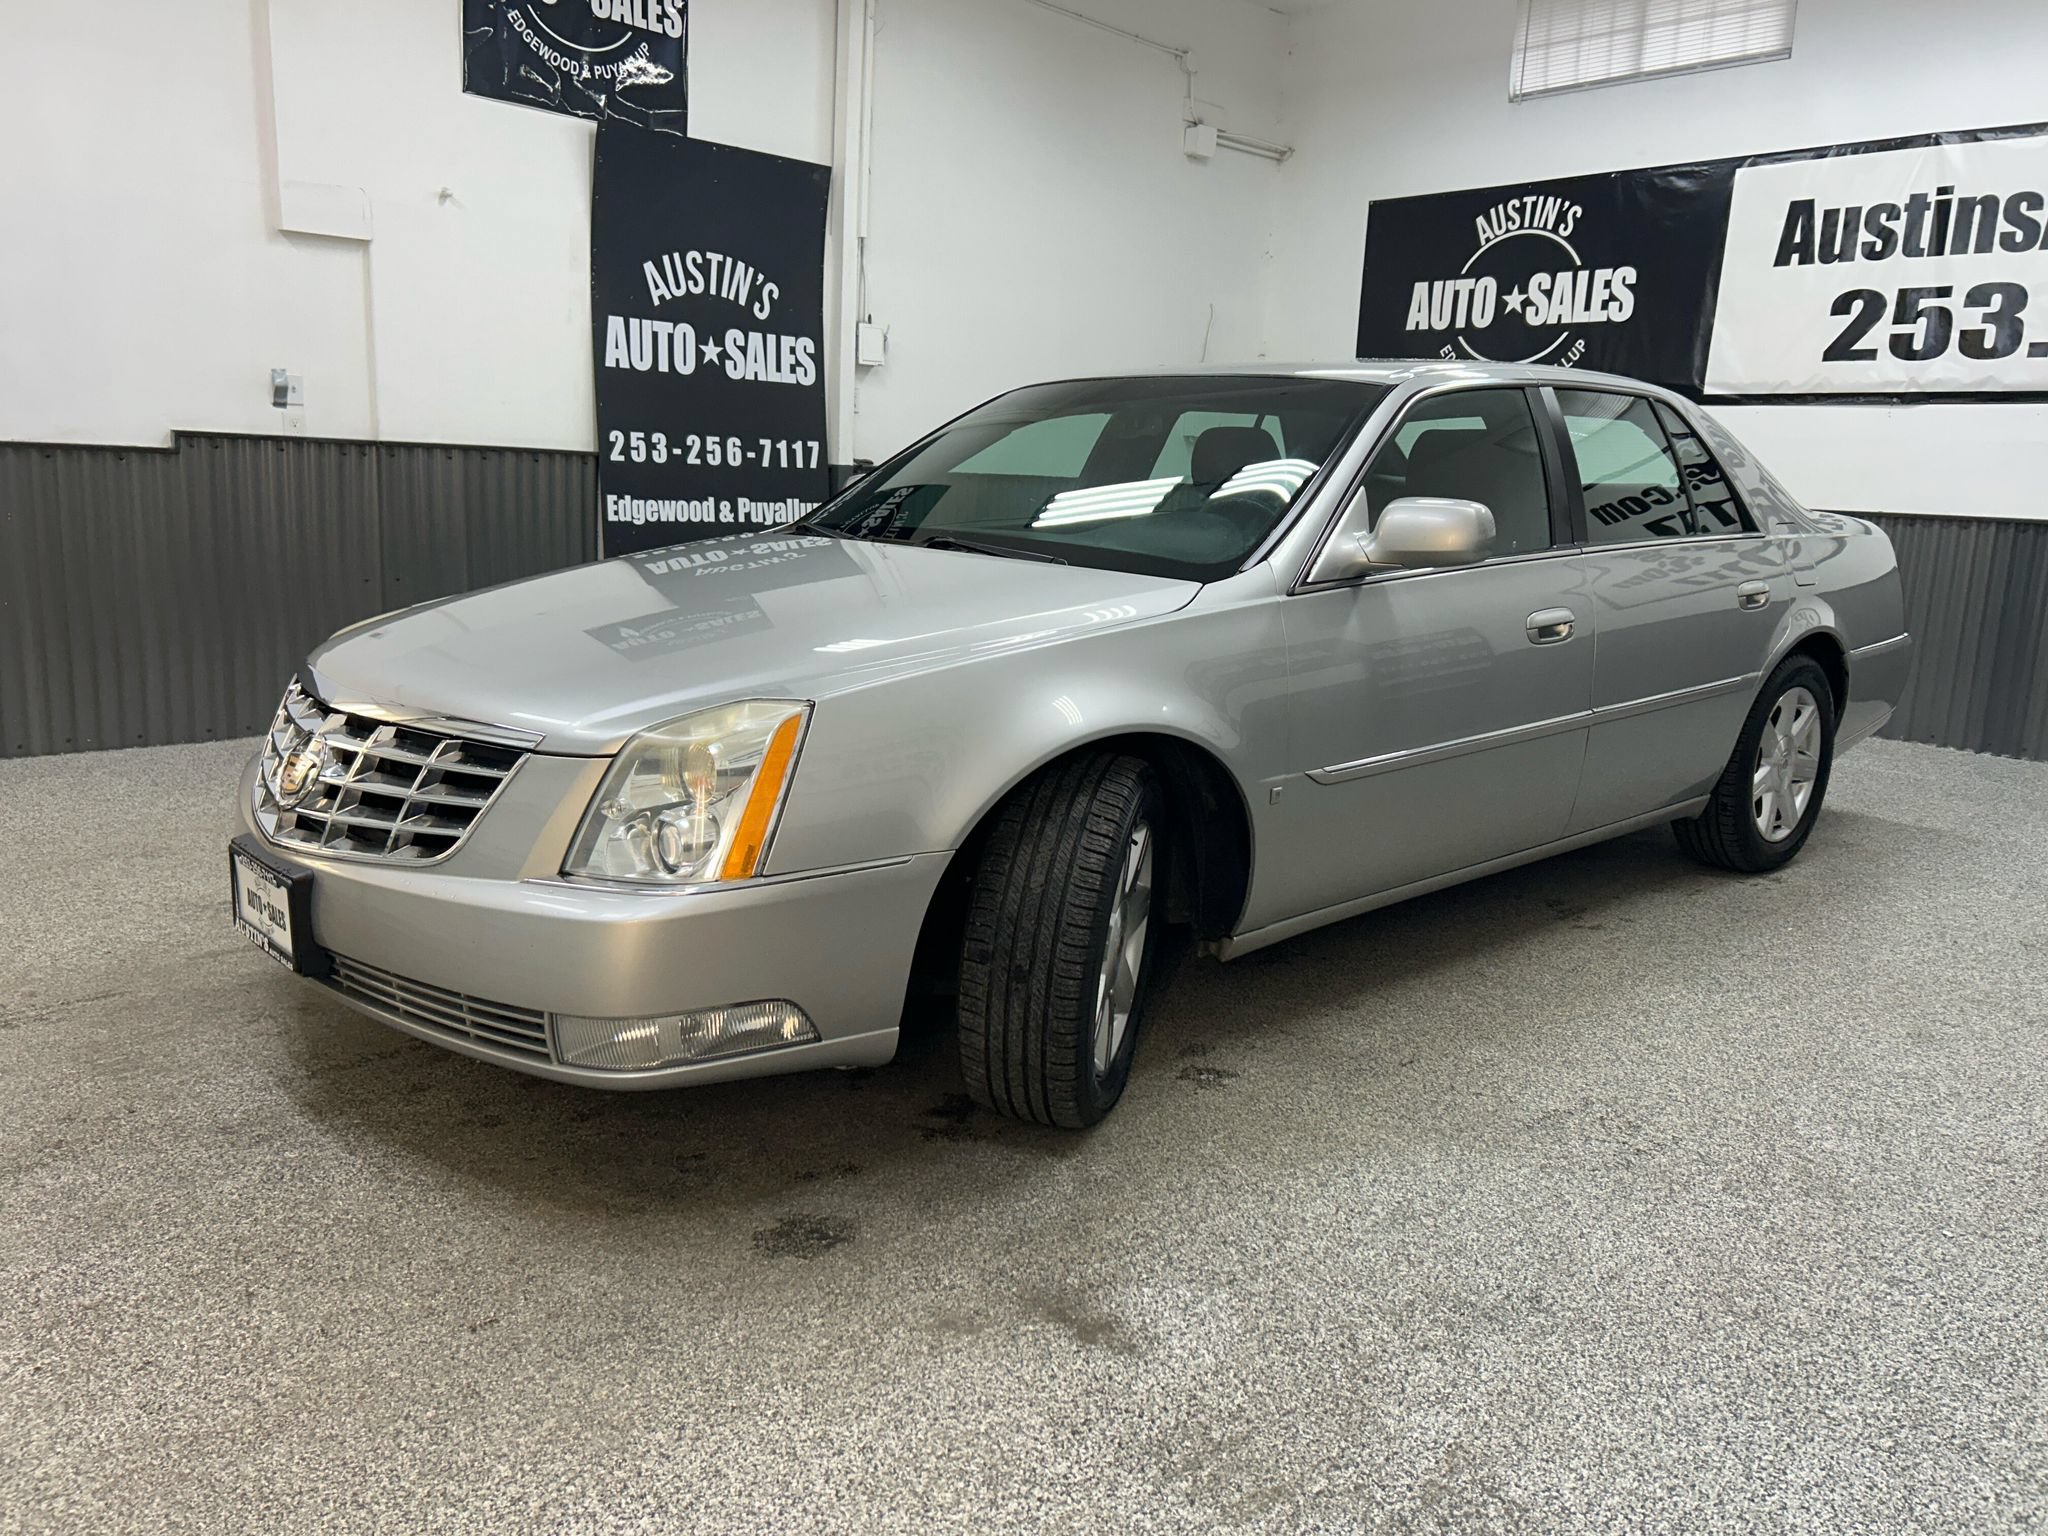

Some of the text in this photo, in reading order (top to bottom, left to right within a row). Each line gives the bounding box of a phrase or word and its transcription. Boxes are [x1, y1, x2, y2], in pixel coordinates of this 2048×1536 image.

[507, 9, 580, 75] EDGEWOOD
[580, 64, 592, 80] &
[1475, 195, 1583, 246] AUSTIN'S
[1773, 185, 2048, 267] Austins
[643, 250, 780, 320] AUSTIN'S
[1405, 266, 1637, 331] AUTO SALES
[605, 315, 816, 386] AUTO SALES
[608, 430, 820, 469] 253-256-7117
[606, 494, 716, 525] Edgewood
[719, 501, 735, 523] &
[737, 497, 822, 526] Puyallu
[247, 887, 264, 915] AUTO
[267, 901, 287, 932] SALES
